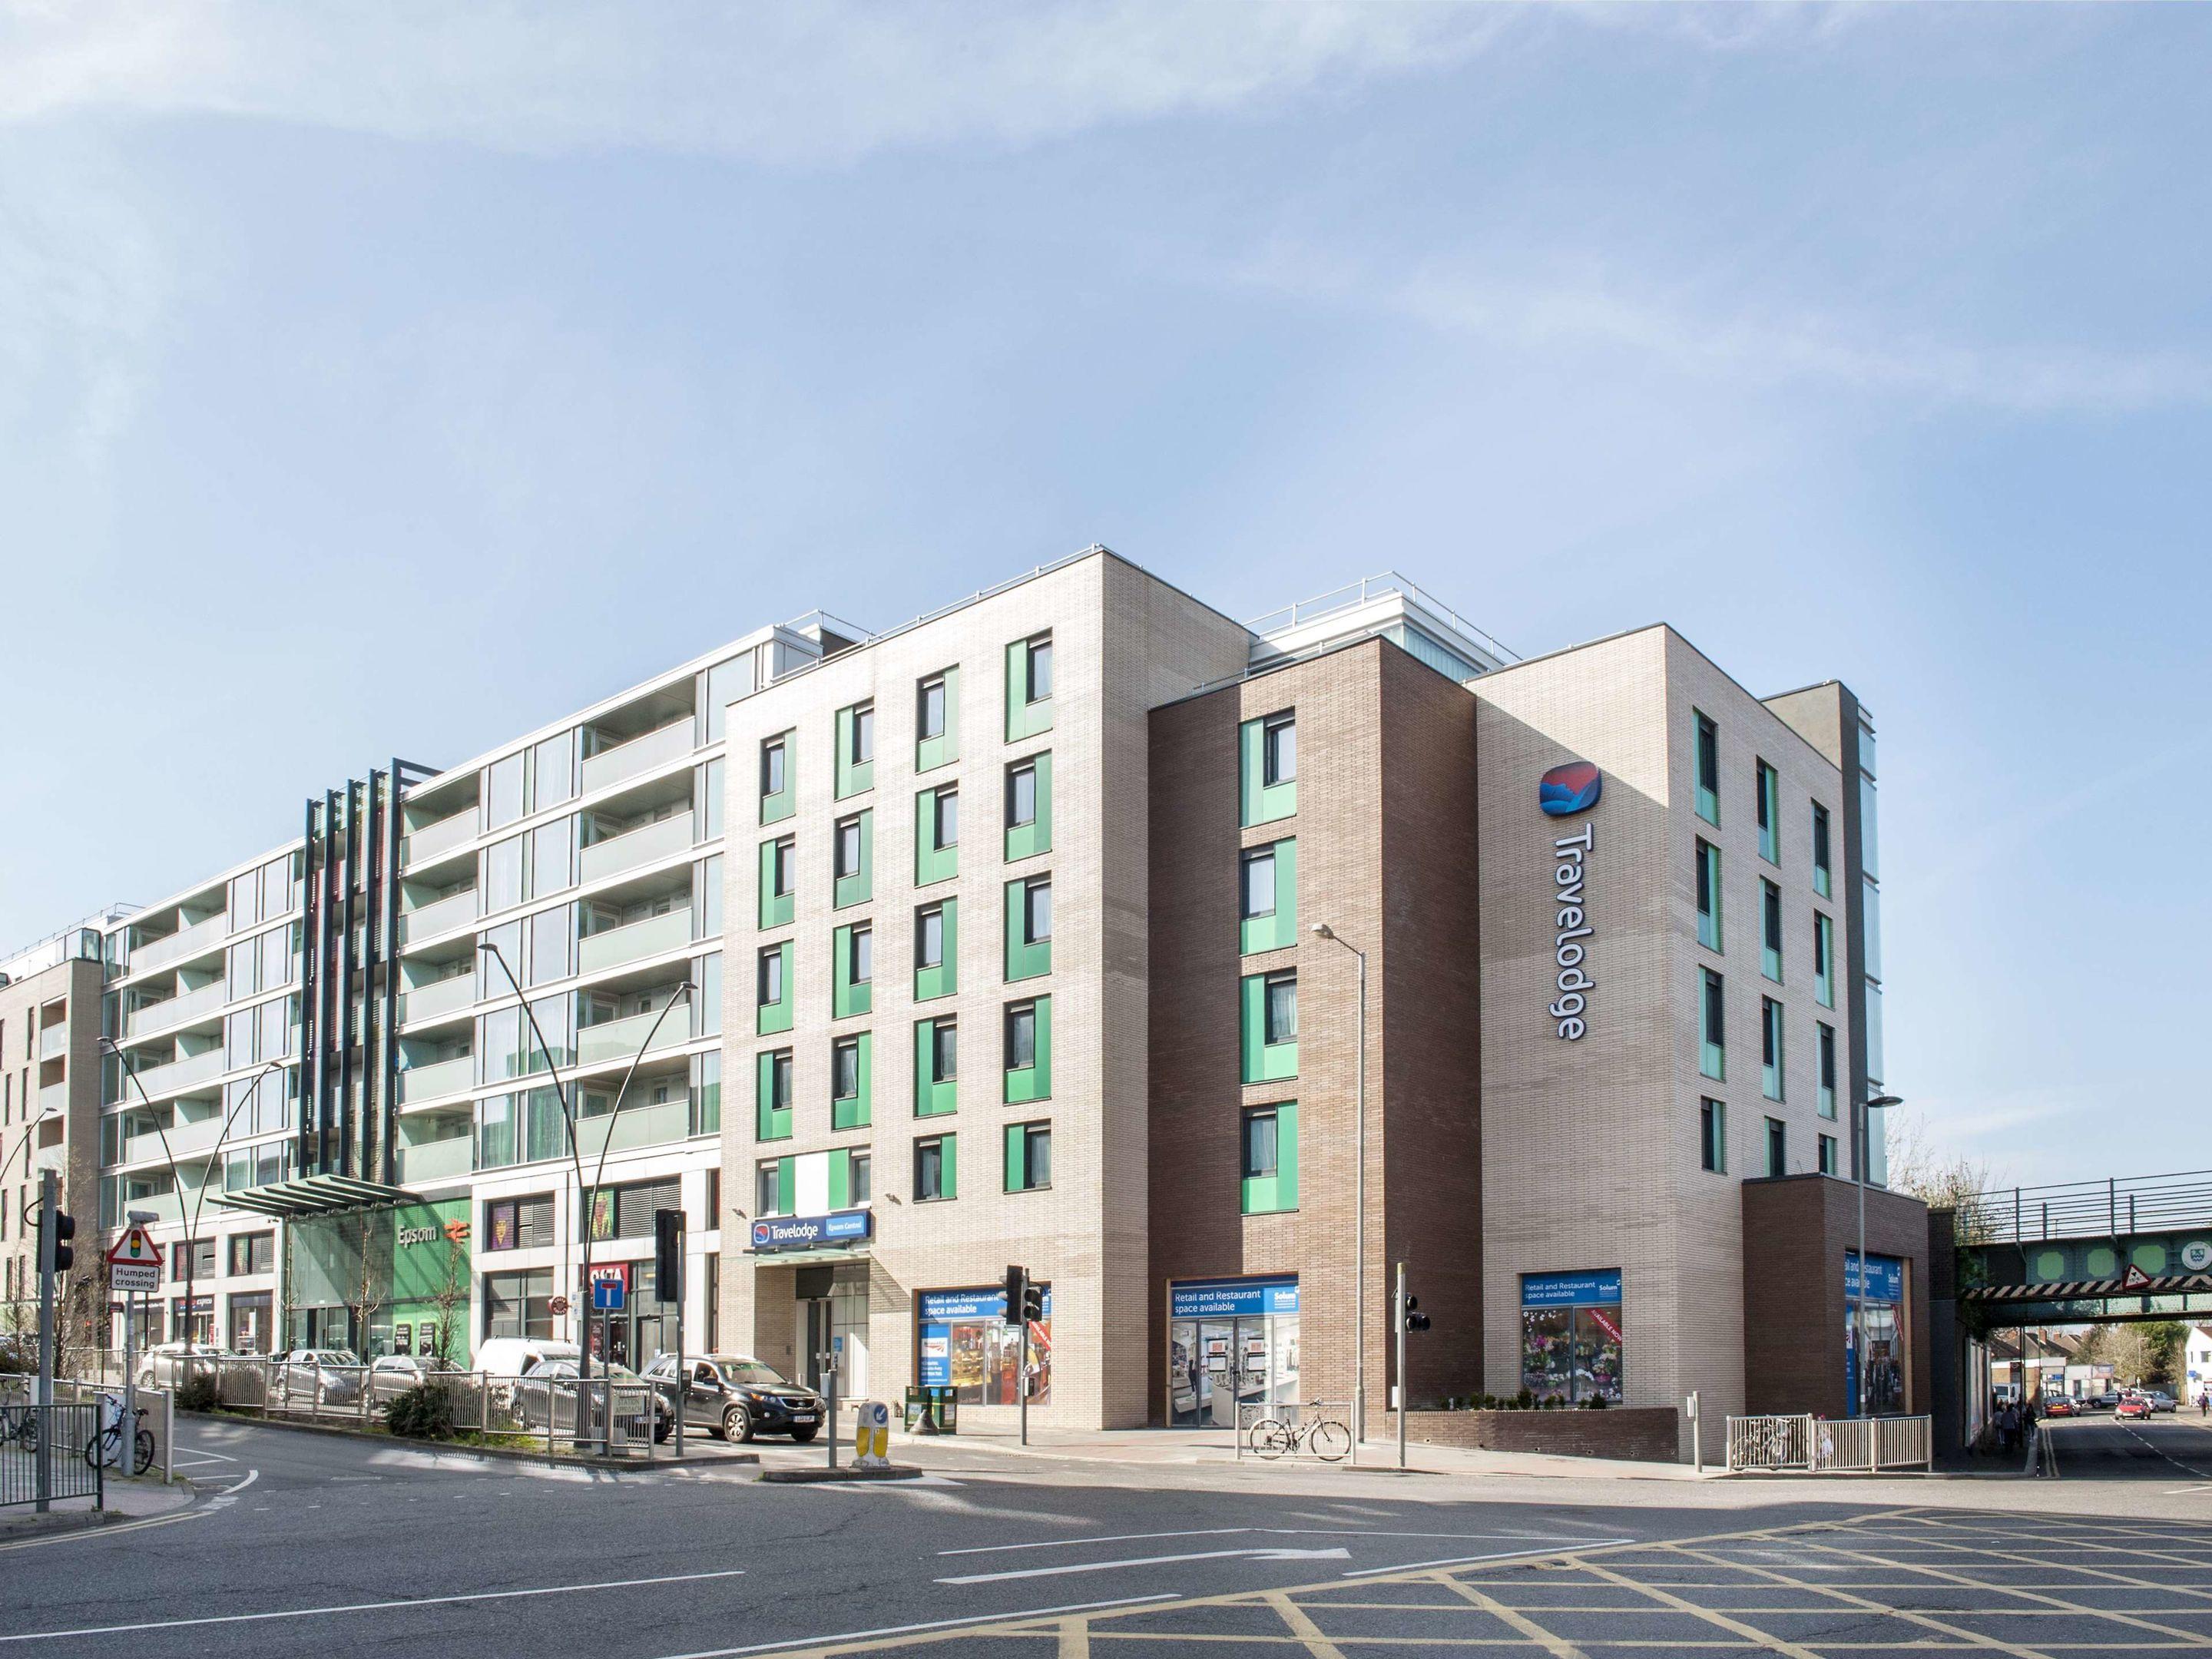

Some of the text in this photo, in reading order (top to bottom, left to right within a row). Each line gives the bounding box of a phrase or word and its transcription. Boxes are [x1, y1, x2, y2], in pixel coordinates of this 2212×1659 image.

[1549, 823, 1594, 1040] Travelodge
[398, 1225, 437, 1248] Epsom
[771, 1223, 818, 1240] Travelodge
[116, 1268, 155, 1278] Humped
[589, 1268, 622, 1284] OSTA
[115, 1279, 154, 1289] crossing
[1559, 1281, 1595, 1290] Restaurant
[925, 1295, 944, 1304] Retail
[945, 1295, 959, 1303] and
[1175, 1293, 1197, 1302] Retail
[1217, 1290, 1260, 1300] Restaurant
[925, 1304, 977, 1316] space available
[1175, 1303, 1235, 1314] space available
